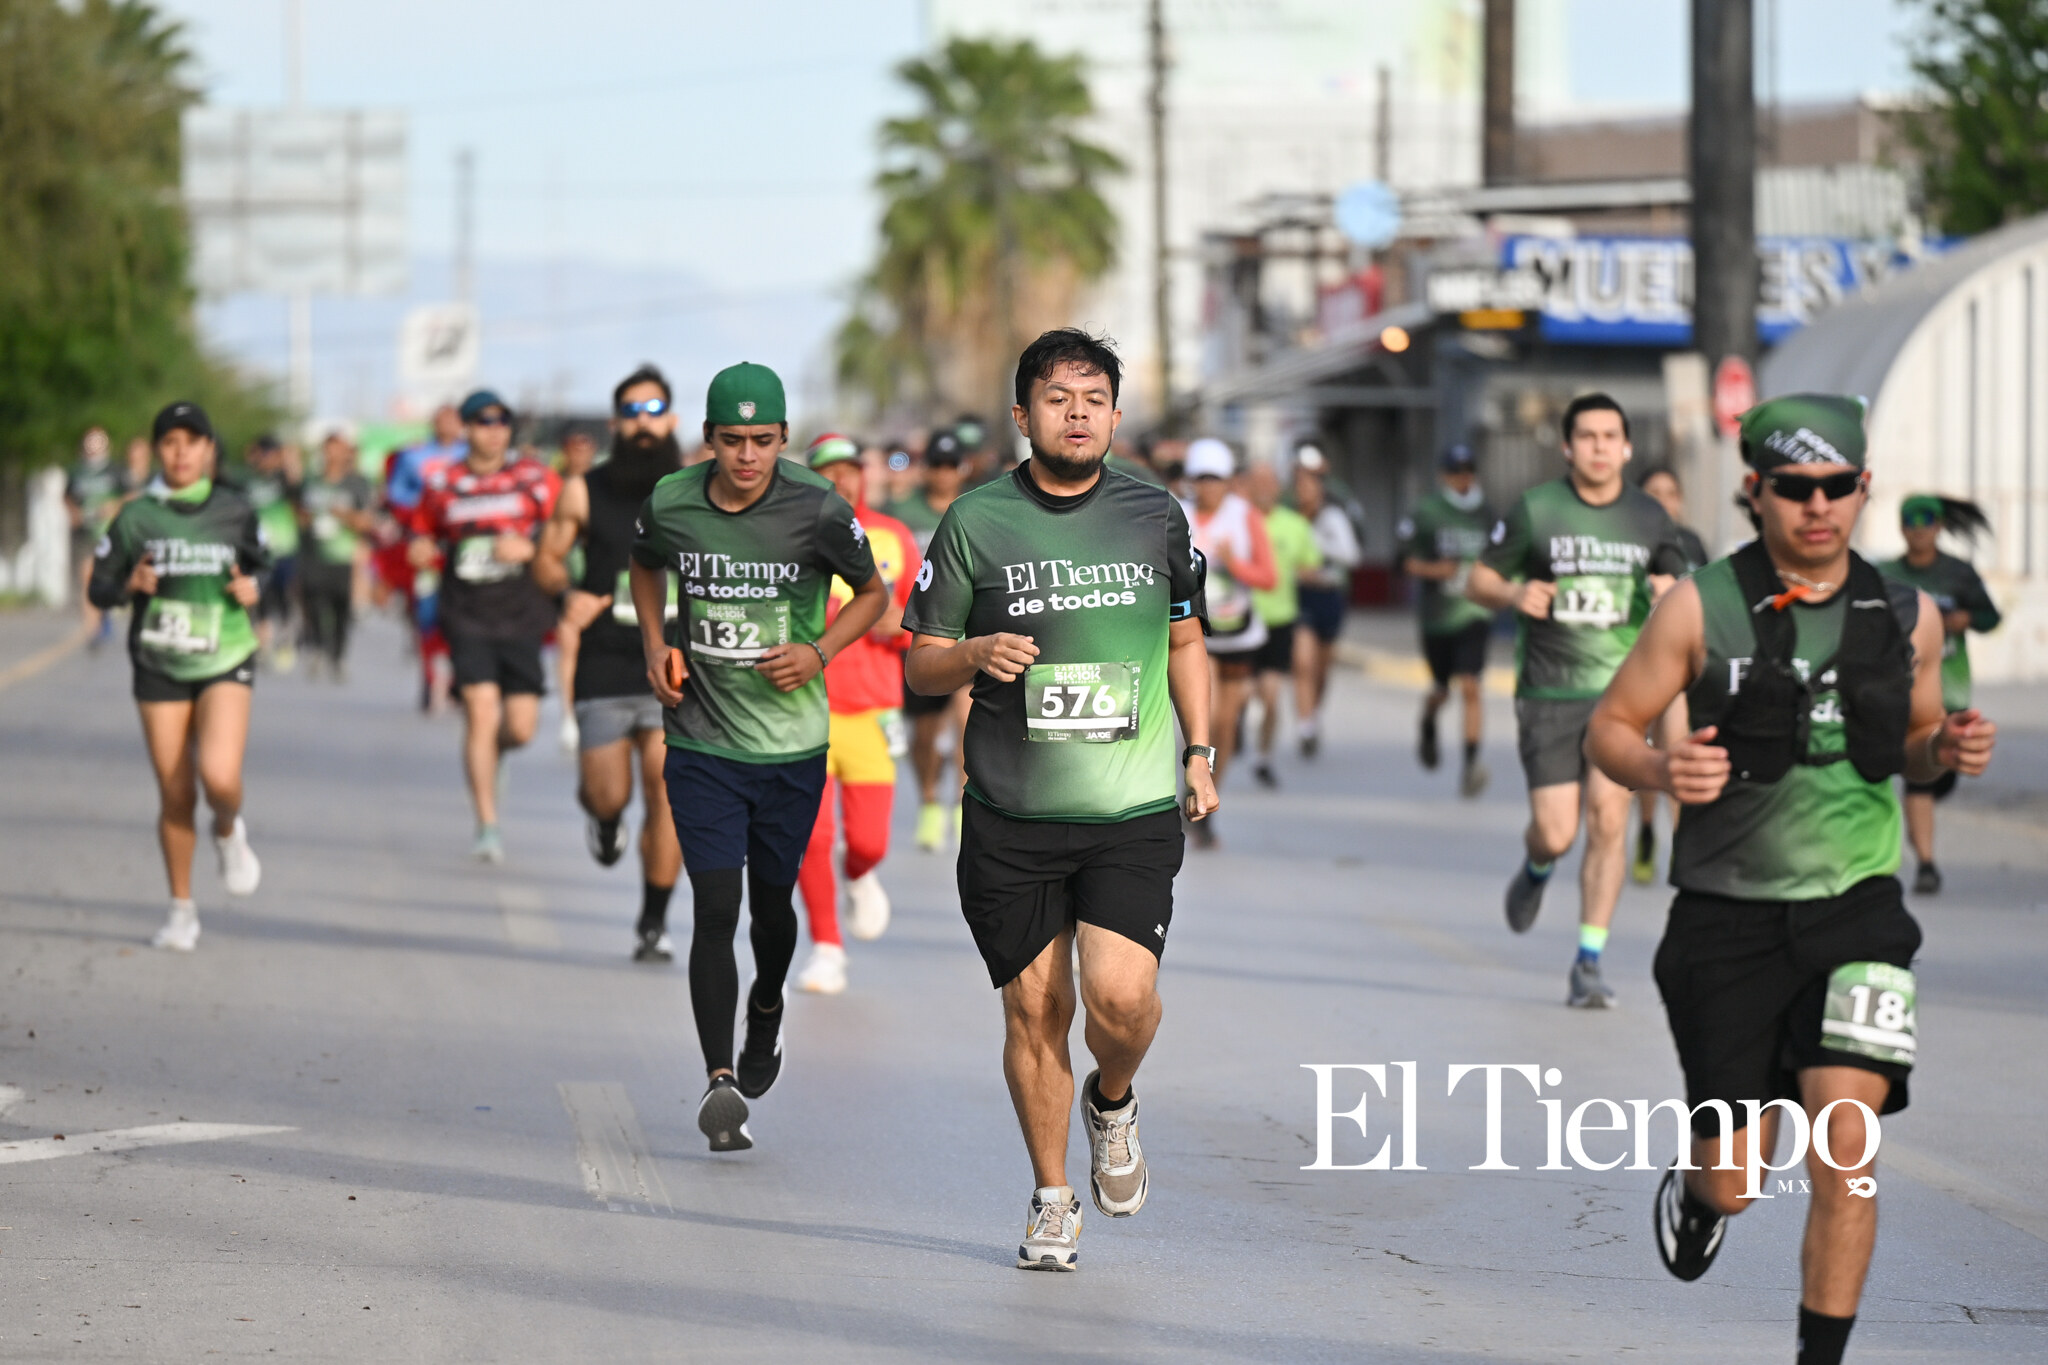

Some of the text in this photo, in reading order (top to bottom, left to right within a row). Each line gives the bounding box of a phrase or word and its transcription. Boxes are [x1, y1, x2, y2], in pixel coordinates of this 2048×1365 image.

[1575, 535, 1650, 567] Tiempo
[679, 552, 799, 585] El Tiempo
[1002, 559, 1153, 594] El Tiempo
[685, 581, 779, 599] de todos
[1008, 589, 1136, 617] de todos
[700, 620, 760, 649] 132
[778, 616, 787, 644] DALLA
[1054, 664, 1100, 672] CARRERA
[1041, 685, 1116, 718] 576
[1131, 679, 1139, 730] MEDALLA
[1849, 984, 1915, 1032] 18
